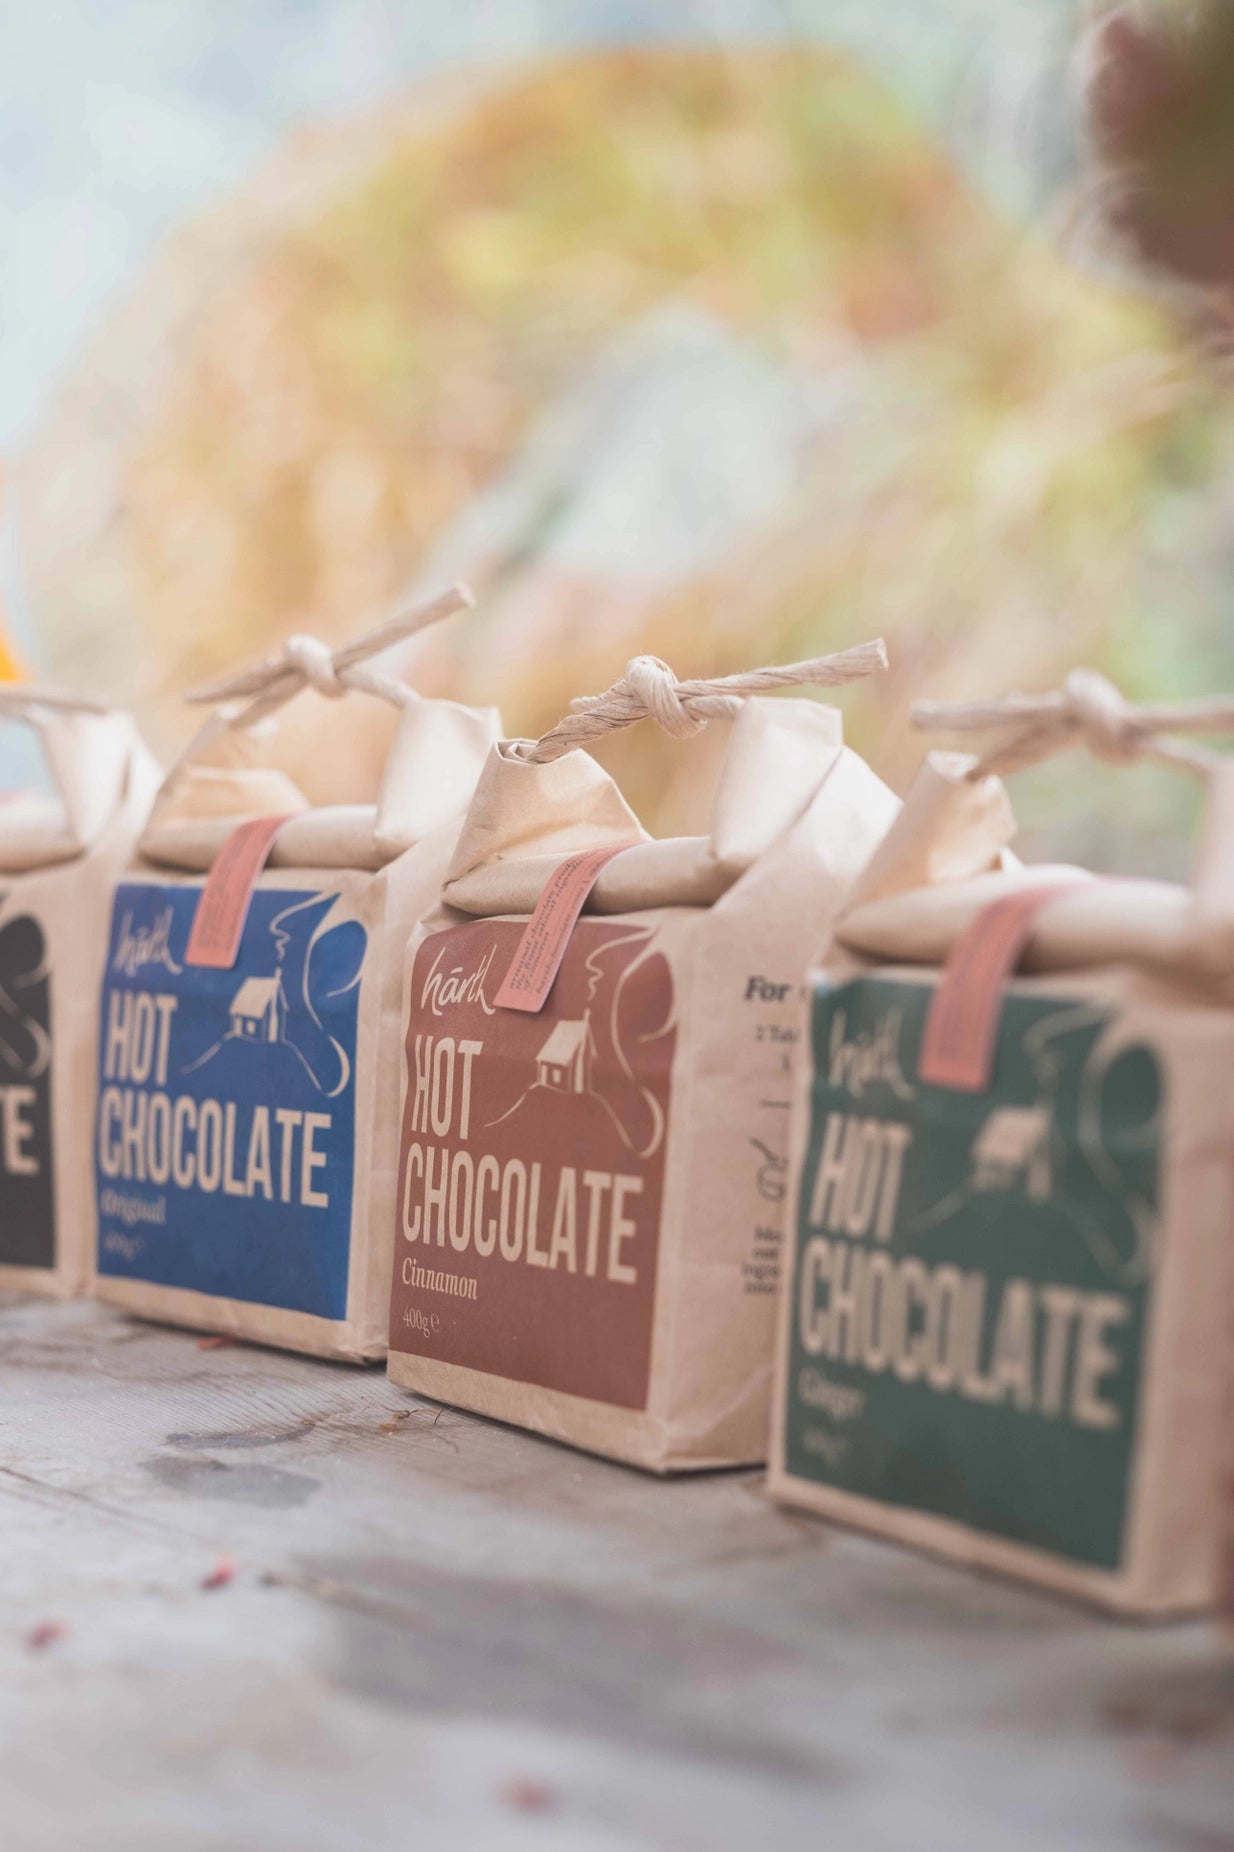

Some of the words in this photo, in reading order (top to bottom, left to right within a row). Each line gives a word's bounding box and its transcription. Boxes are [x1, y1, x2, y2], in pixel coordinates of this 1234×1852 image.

[105, 990, 177, 1085] HOT
[743, 976, 791, 1002] For
[411, 1035, 483, 1140] HOT
[100, 1089, 332, 1207] CHOCOLATE
[809, 1112, 911, 1243] HOT
[402, 1142, 643, 1284] CHOCOLATE
[402, 1257, 478, 1300] Cinnamon
[402, 1306, 431, 1338] 400g
[801, 1235, 1130, 1429] CHOCOLATE
